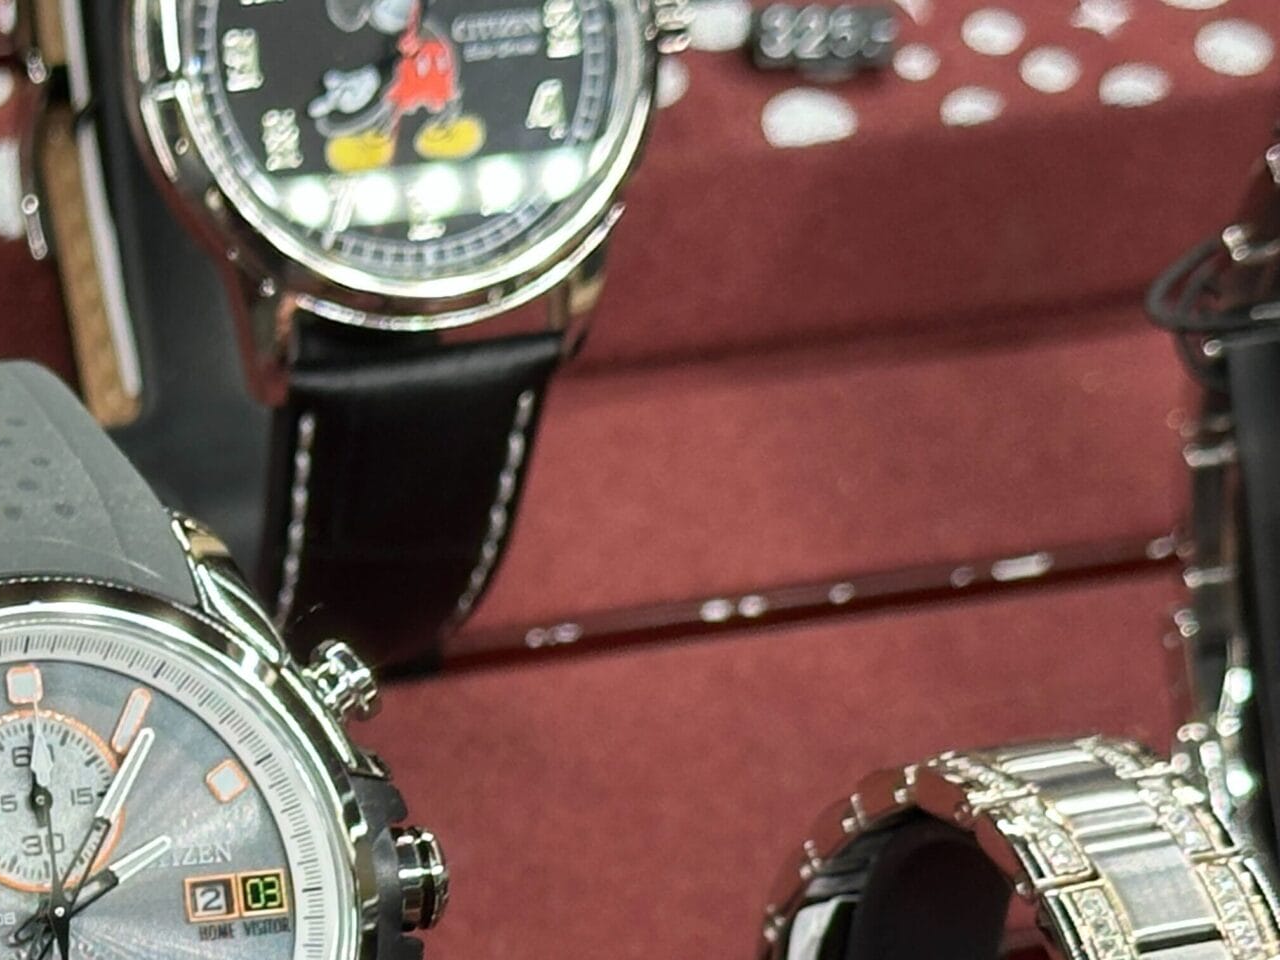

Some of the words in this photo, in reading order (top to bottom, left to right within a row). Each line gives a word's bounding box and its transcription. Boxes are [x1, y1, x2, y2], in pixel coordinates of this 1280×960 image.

[12, 744, 54, 768] 6
[70, 787, 94, 806] 15
[22, 833, 65, 857] 30
[200, 887, 223, 911] 2
[246, 877, 280, 908] 03
